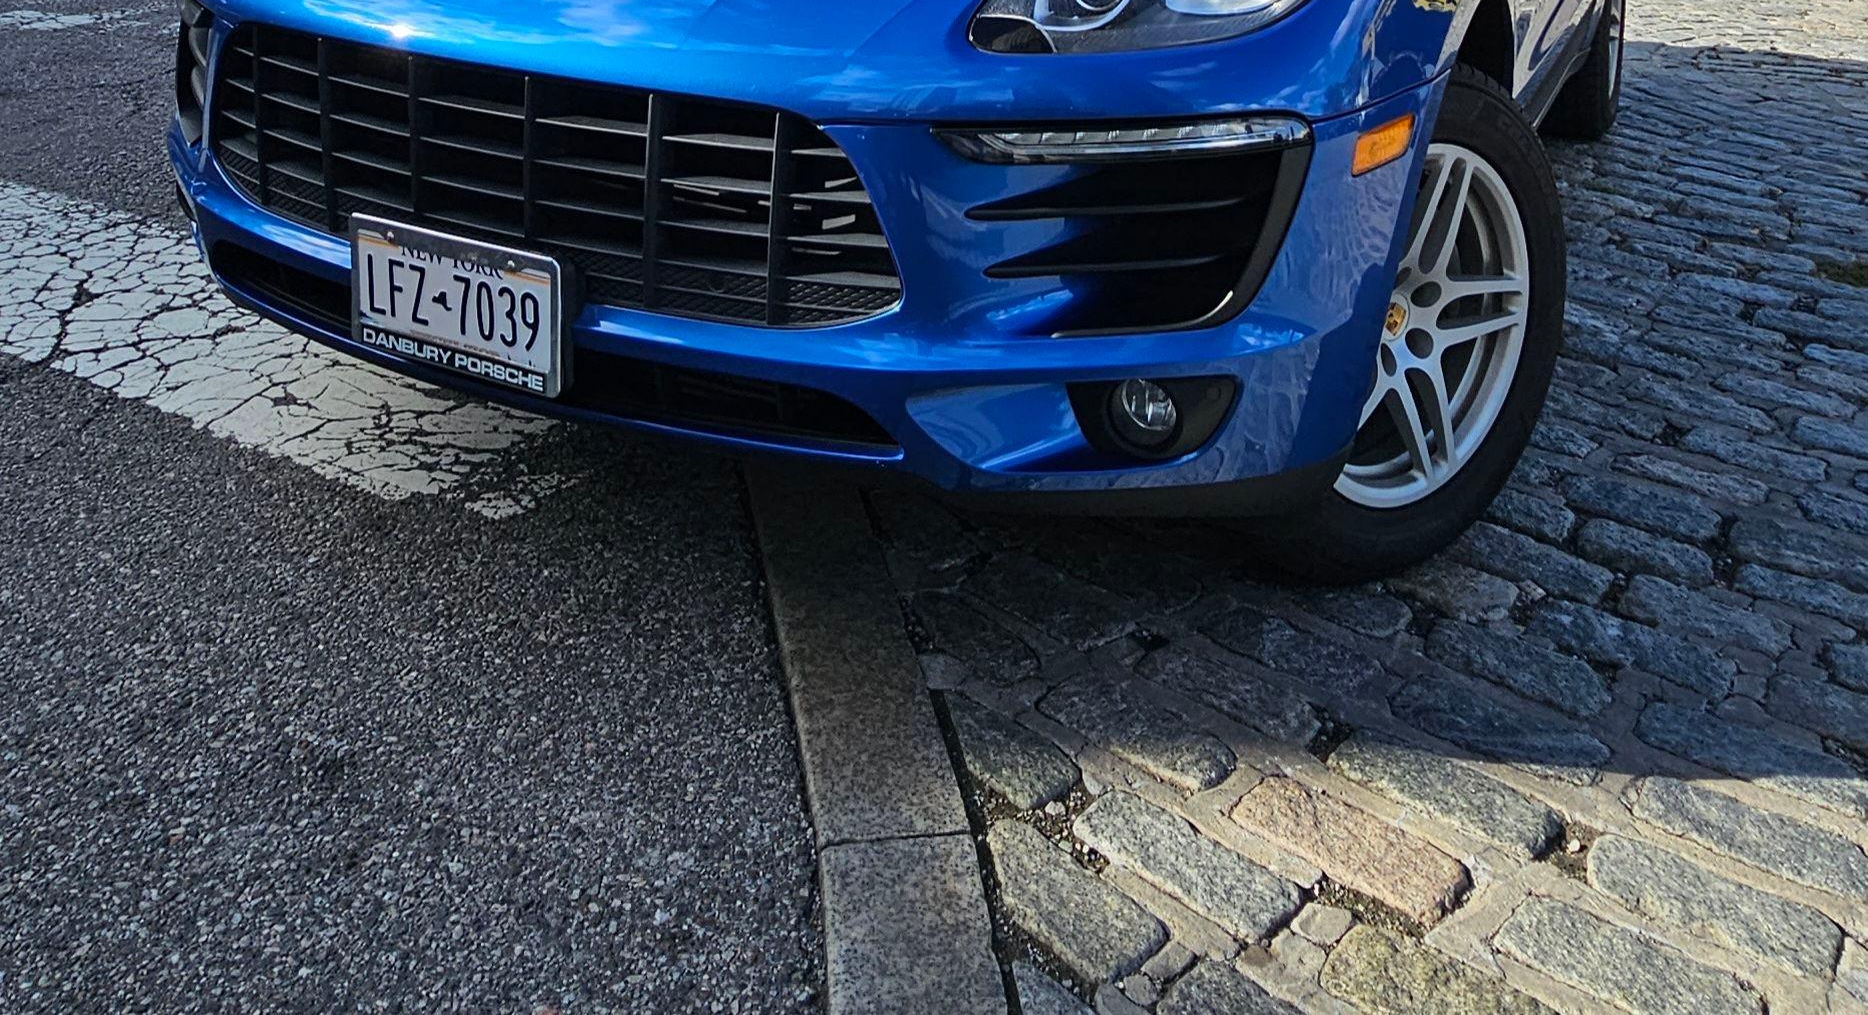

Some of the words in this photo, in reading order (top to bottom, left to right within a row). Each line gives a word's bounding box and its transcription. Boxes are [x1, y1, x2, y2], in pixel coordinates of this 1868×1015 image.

[367, 253, 429, 326] LFZ
[453, 274, 540, 352] 7039
[363, 328, 453, 365] DANBURY
[454, 352, 544, 392] PORSCHE
